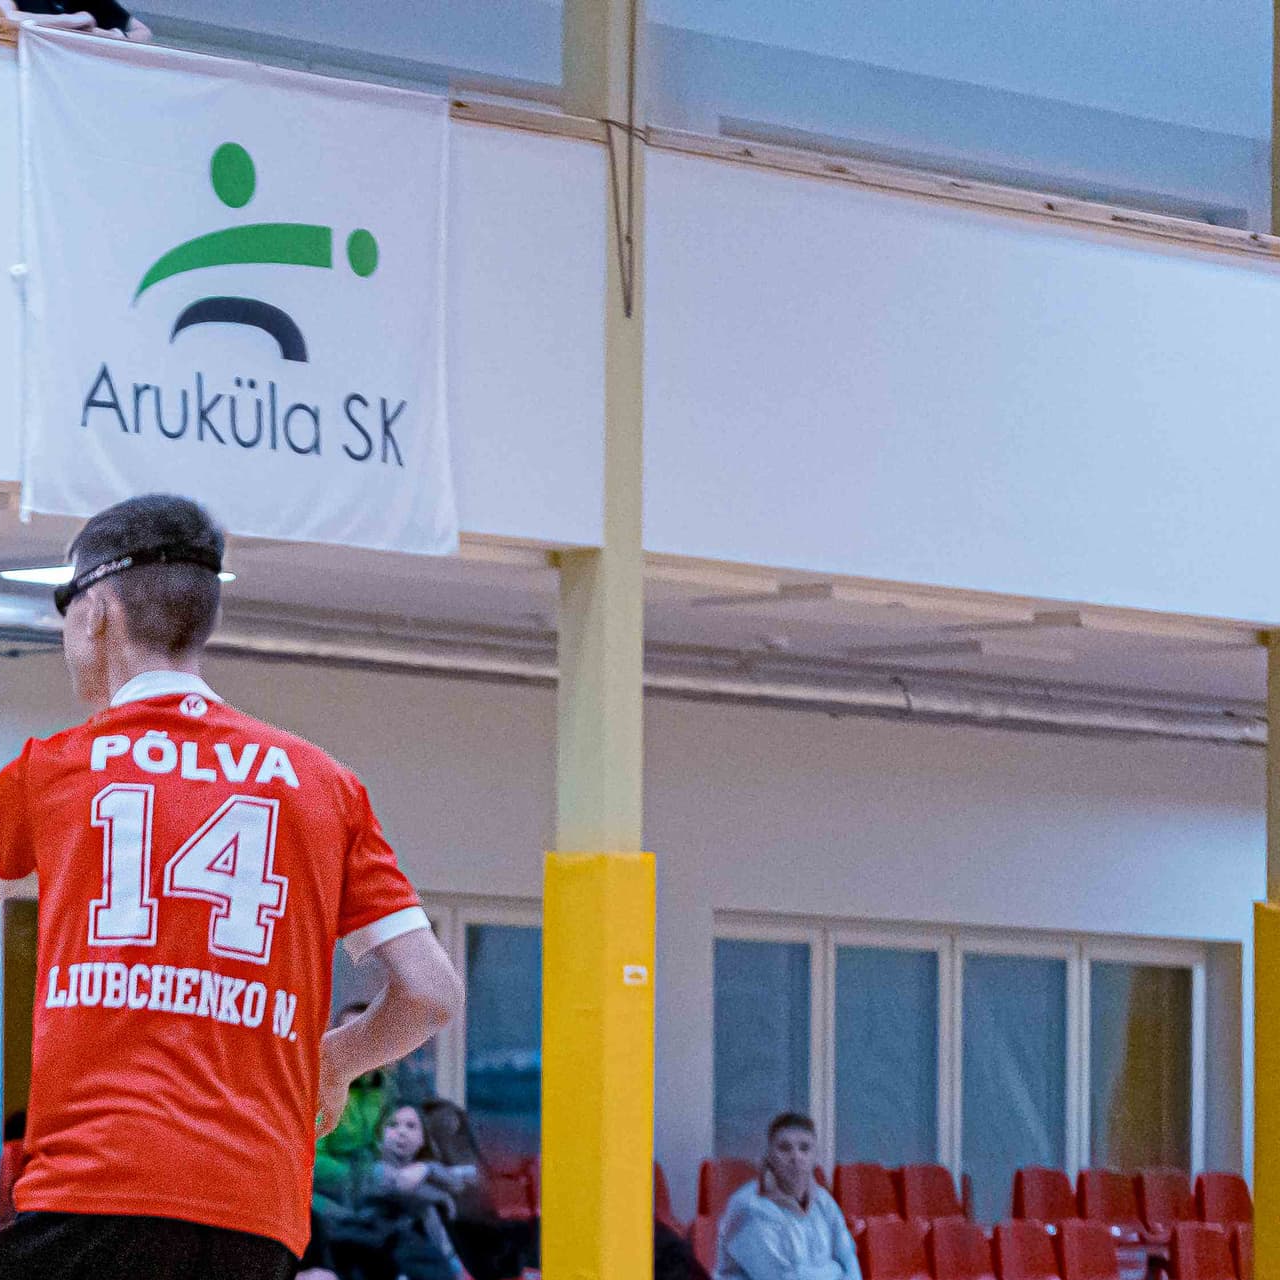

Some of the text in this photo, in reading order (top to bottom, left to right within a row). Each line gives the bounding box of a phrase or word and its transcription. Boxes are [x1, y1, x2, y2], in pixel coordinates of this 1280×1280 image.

[80, 362, 407, 467] Aruküla SK
[90, 730, 301, 789] PÕLVA
[87, 783, 288, 966] 14
[45, 961, 297, 1042] LIUBCHENKO N.
